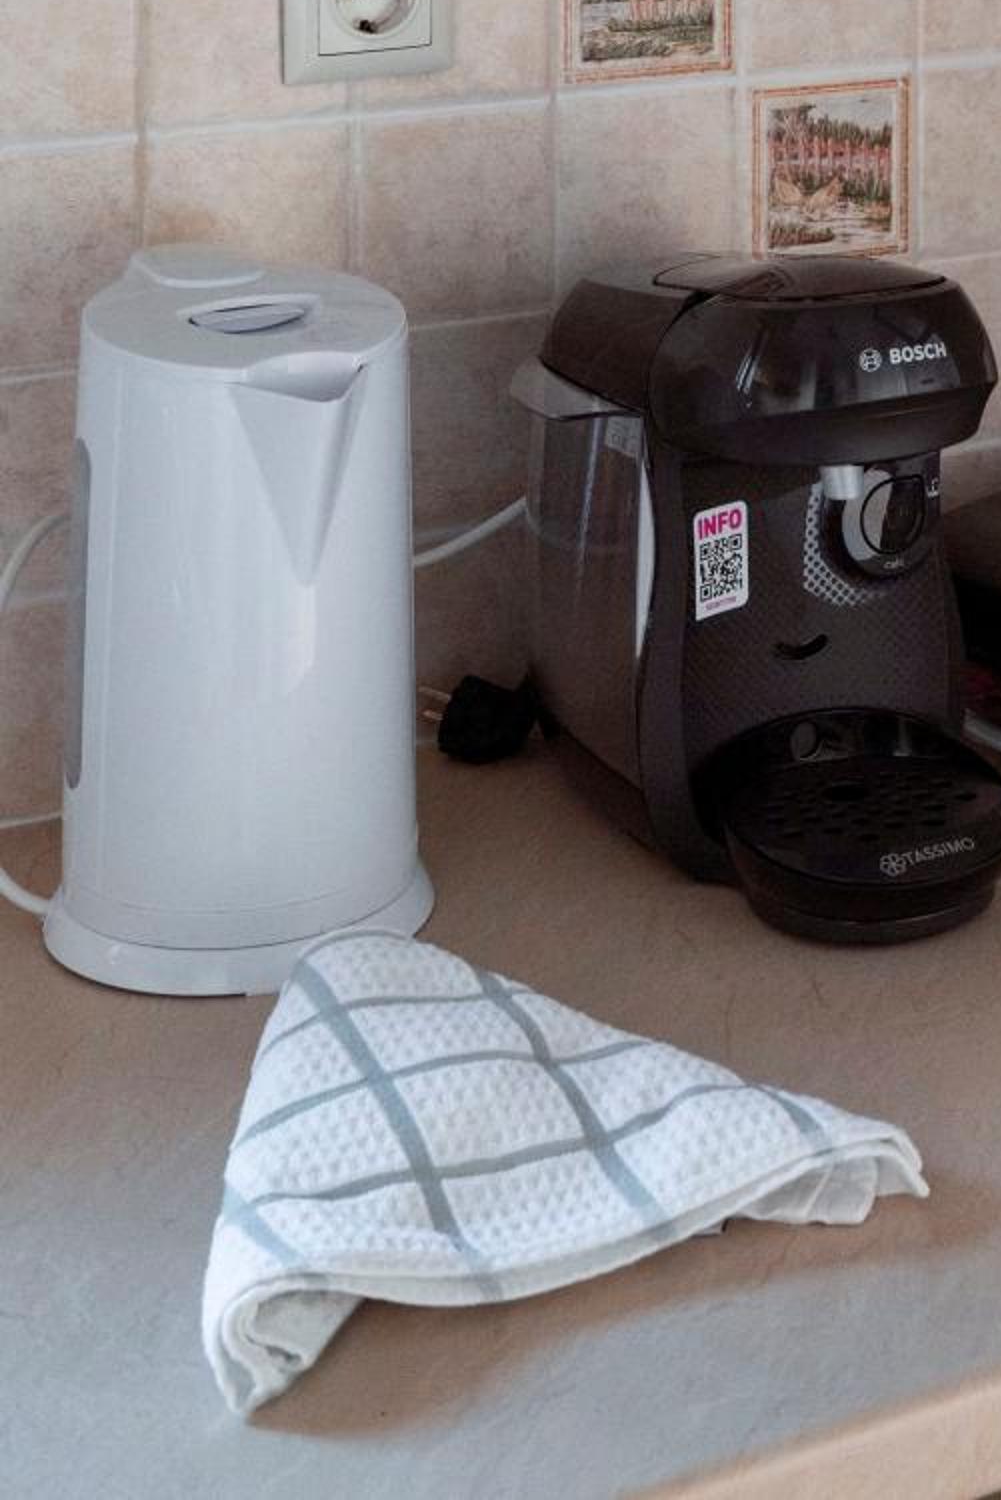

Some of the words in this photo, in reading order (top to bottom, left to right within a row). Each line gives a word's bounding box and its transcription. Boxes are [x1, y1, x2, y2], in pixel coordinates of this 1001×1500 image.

[889, 341, 947, 365] BOSCH
[698, 509, 742, 541] INFO
[901, 836, 975, 866] TASSIMO
